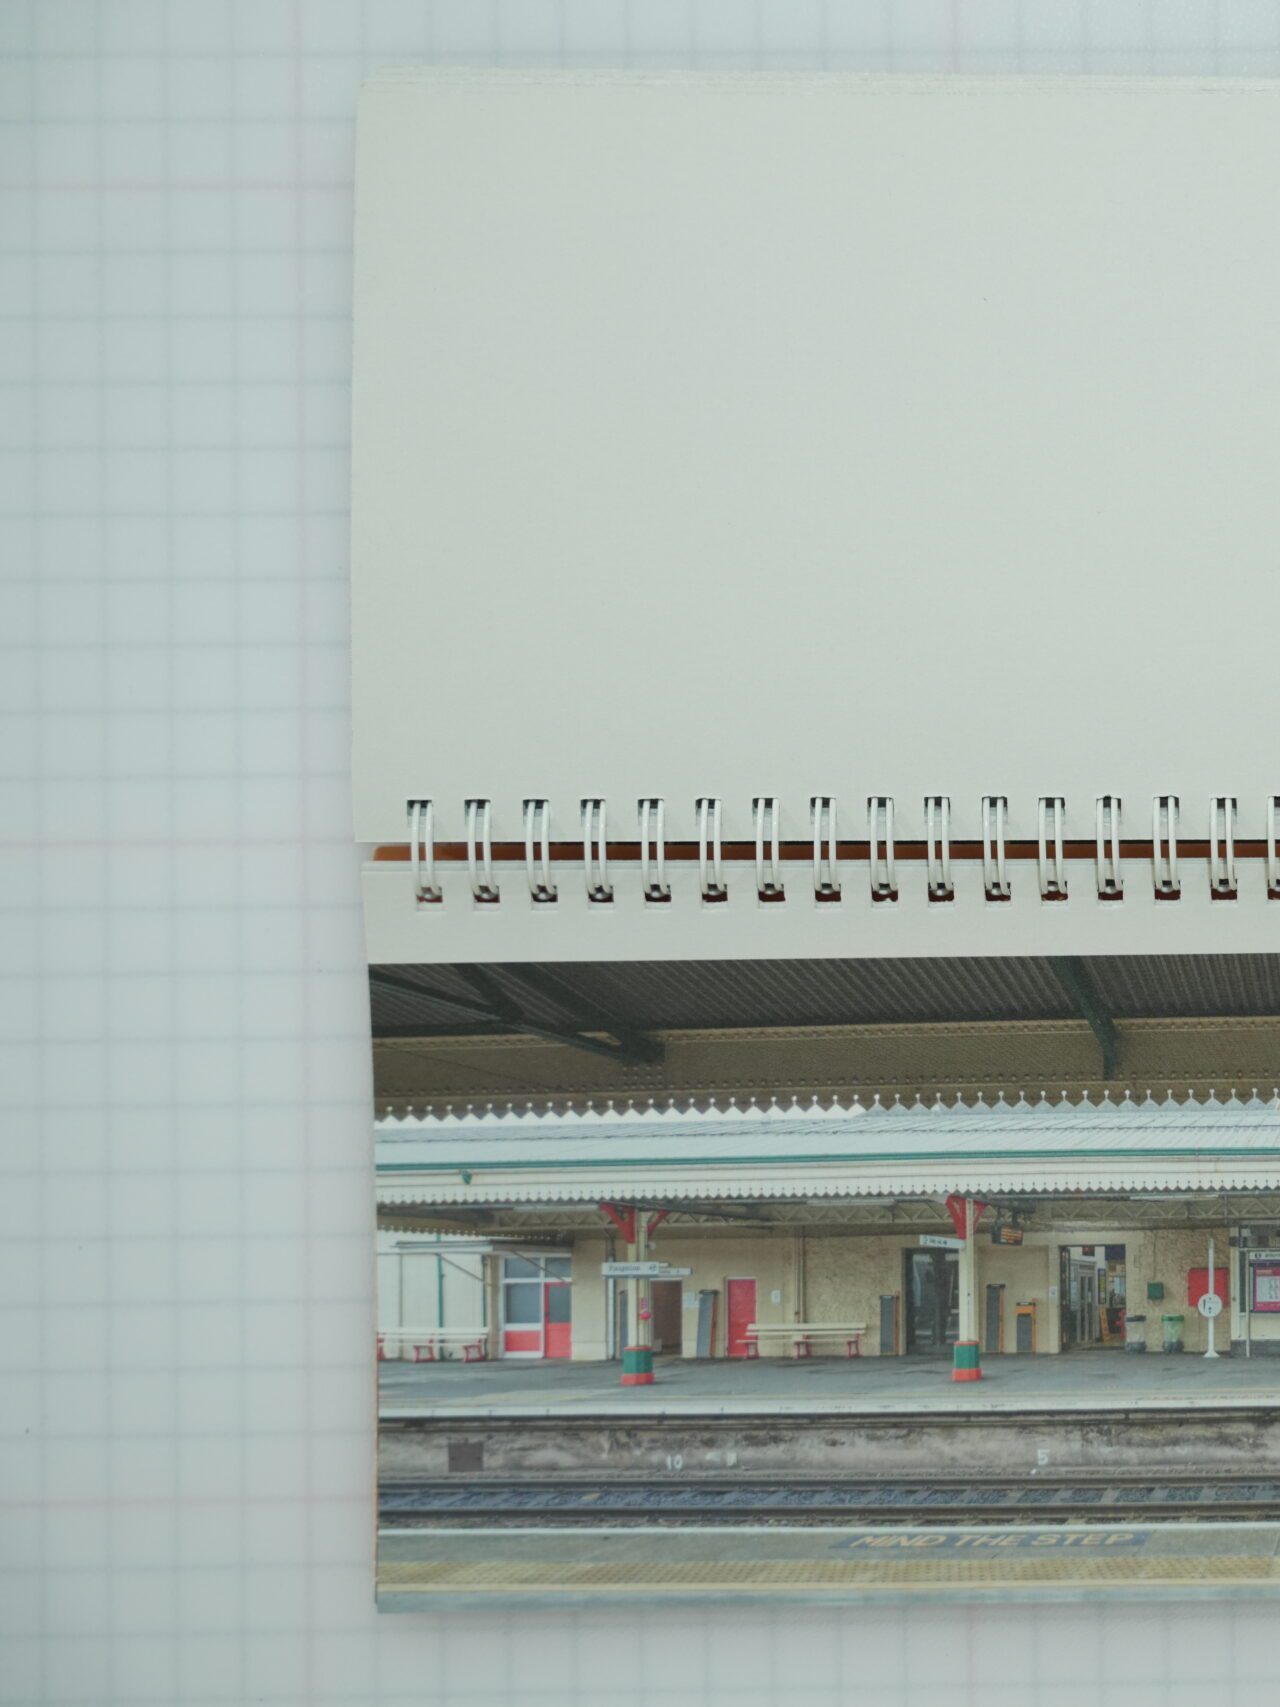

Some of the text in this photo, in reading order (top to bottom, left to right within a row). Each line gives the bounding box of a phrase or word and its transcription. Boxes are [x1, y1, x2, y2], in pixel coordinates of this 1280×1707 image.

[665, 1453, 684, 1470] 10
[851, 1533, 1134, 1546] MIND THE STEP
